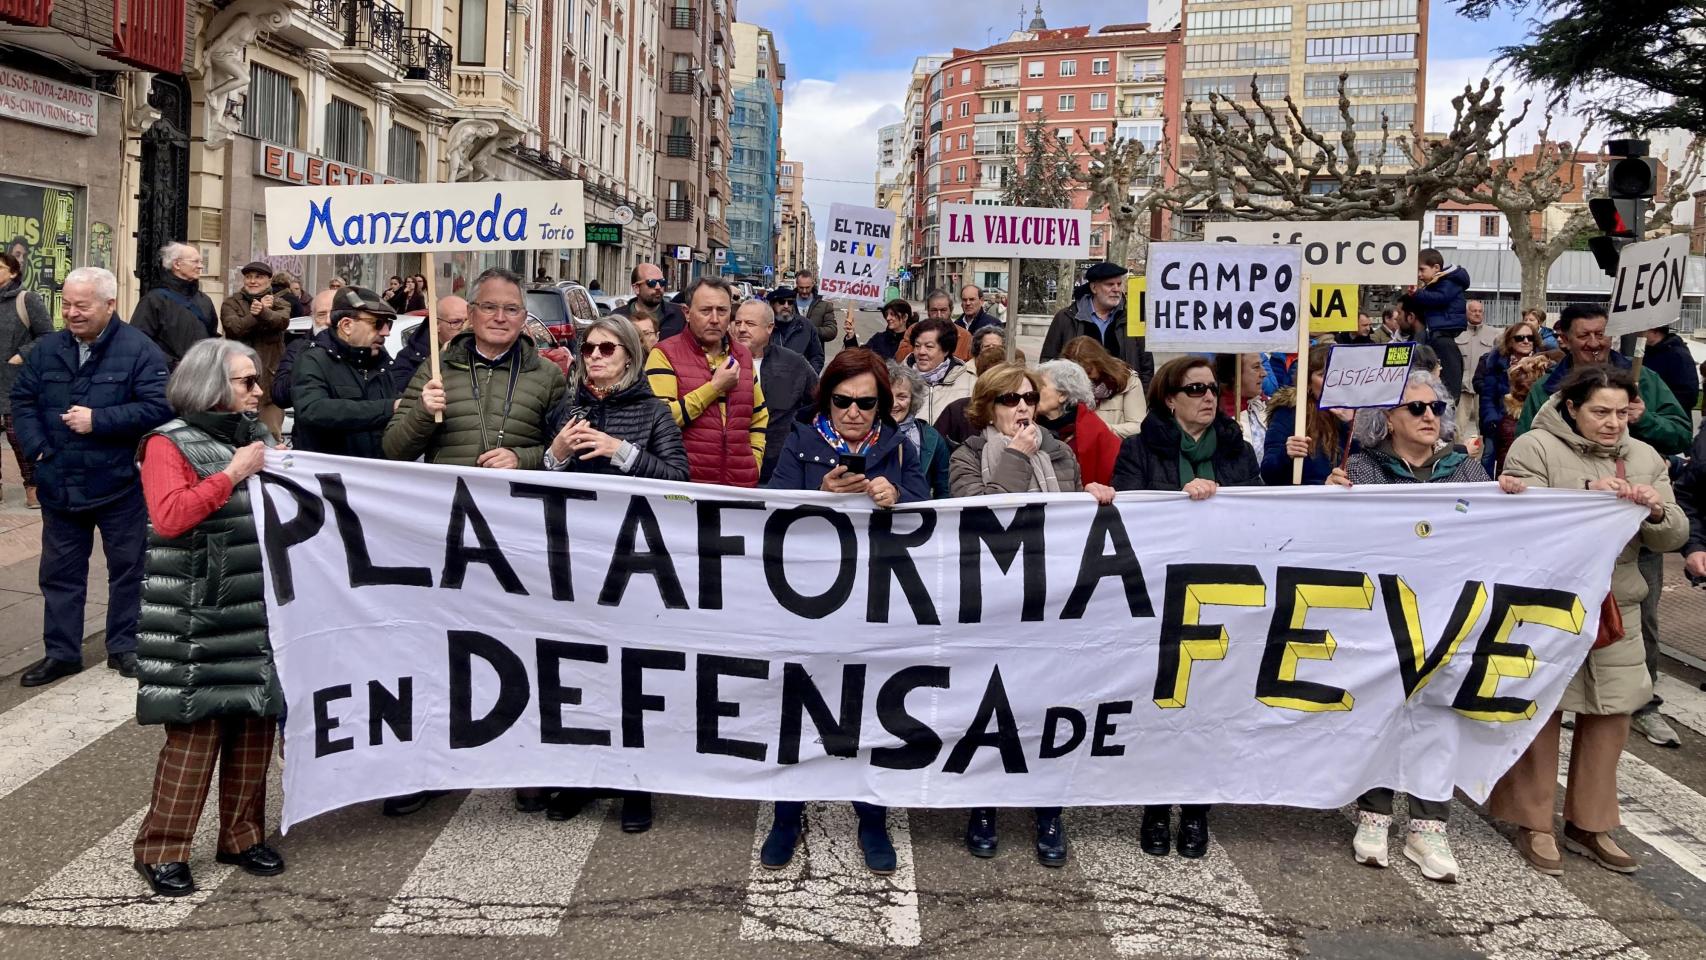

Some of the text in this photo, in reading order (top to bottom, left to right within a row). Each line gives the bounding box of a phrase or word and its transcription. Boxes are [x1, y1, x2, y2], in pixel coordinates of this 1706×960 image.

[288, 193, 528, 250] Manzaneda
[549, 202, 563, 216] de
[834, 218, 891, 239] EL TREN
[948, 213, 1081, 247] LA VALCUEVA
[830, 239, 884, 260] DE FEVE
[834, 260, 872, 277] A LA
[1160, 261, 1293, 293] CAMPO
[1612, 246, 1687, 314] LEÓN
[1154, 300, 1297, 333] HERMOSO
[260, 471, 1156, 626] PLATAFORMA
[313, 563, 1587, 775] EN DEFENSA DE FEVE
